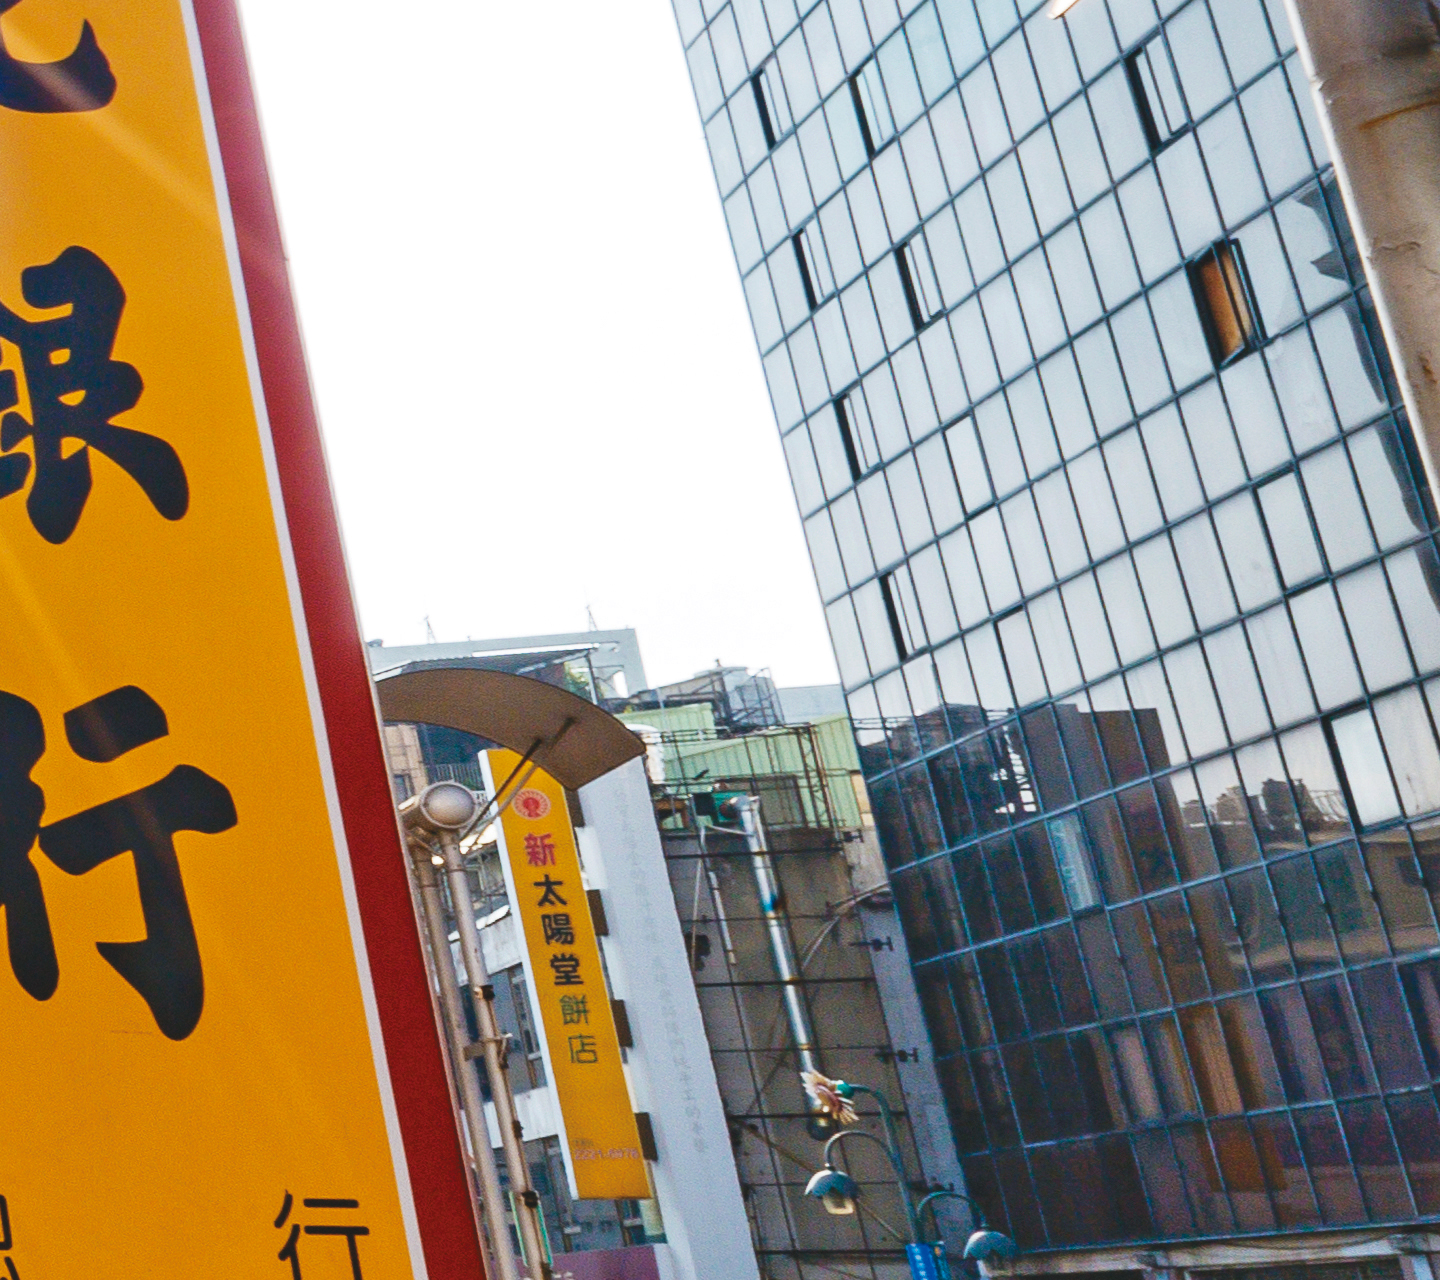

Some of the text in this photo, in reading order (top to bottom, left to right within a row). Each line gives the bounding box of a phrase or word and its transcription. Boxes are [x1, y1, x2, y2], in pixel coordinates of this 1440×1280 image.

[523, 831, 598, 1064] 新太陽堂餅店
